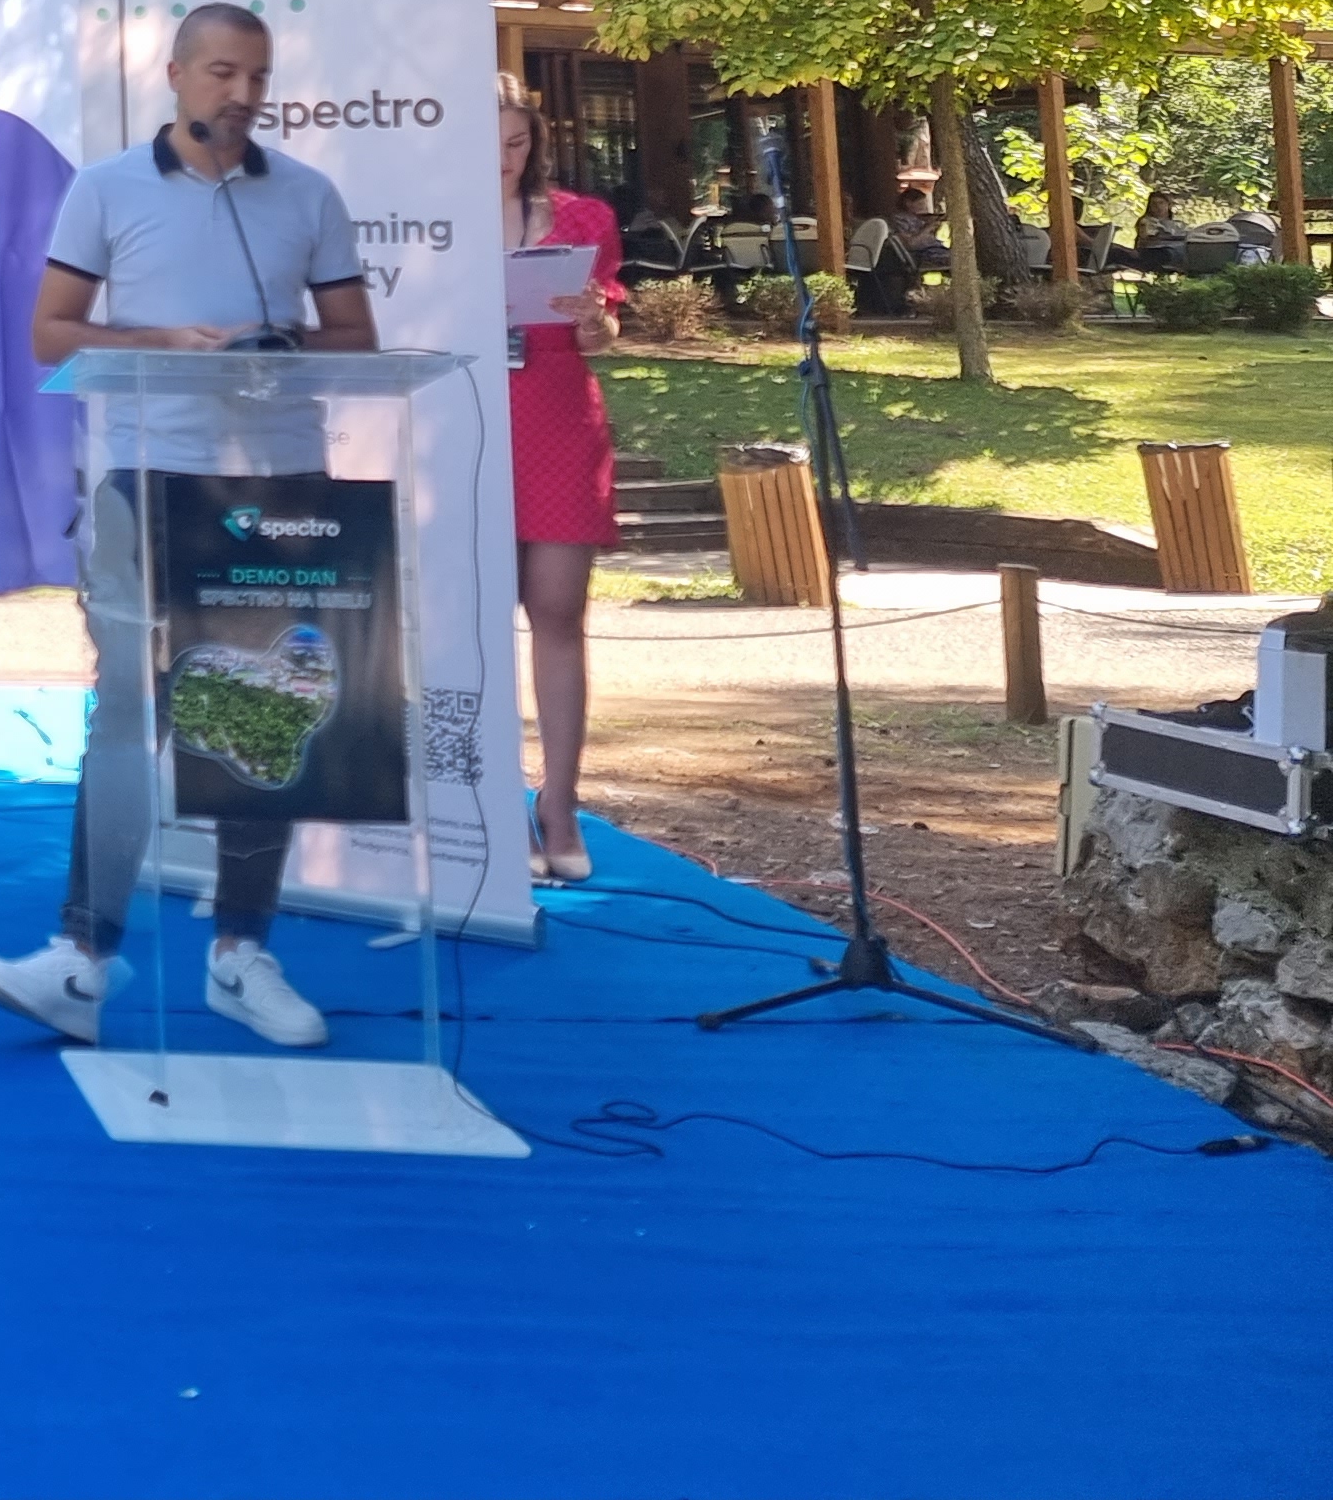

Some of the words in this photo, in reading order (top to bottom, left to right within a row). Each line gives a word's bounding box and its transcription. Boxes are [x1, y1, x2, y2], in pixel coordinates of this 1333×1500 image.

[257, 89, 445, 140] spectro
[351, 212, 453, 252] ming
[259, 516, 342, 540] spectro
[231, 567, 290, 585] DEMO
[294, 569, 337, 587] DAN
